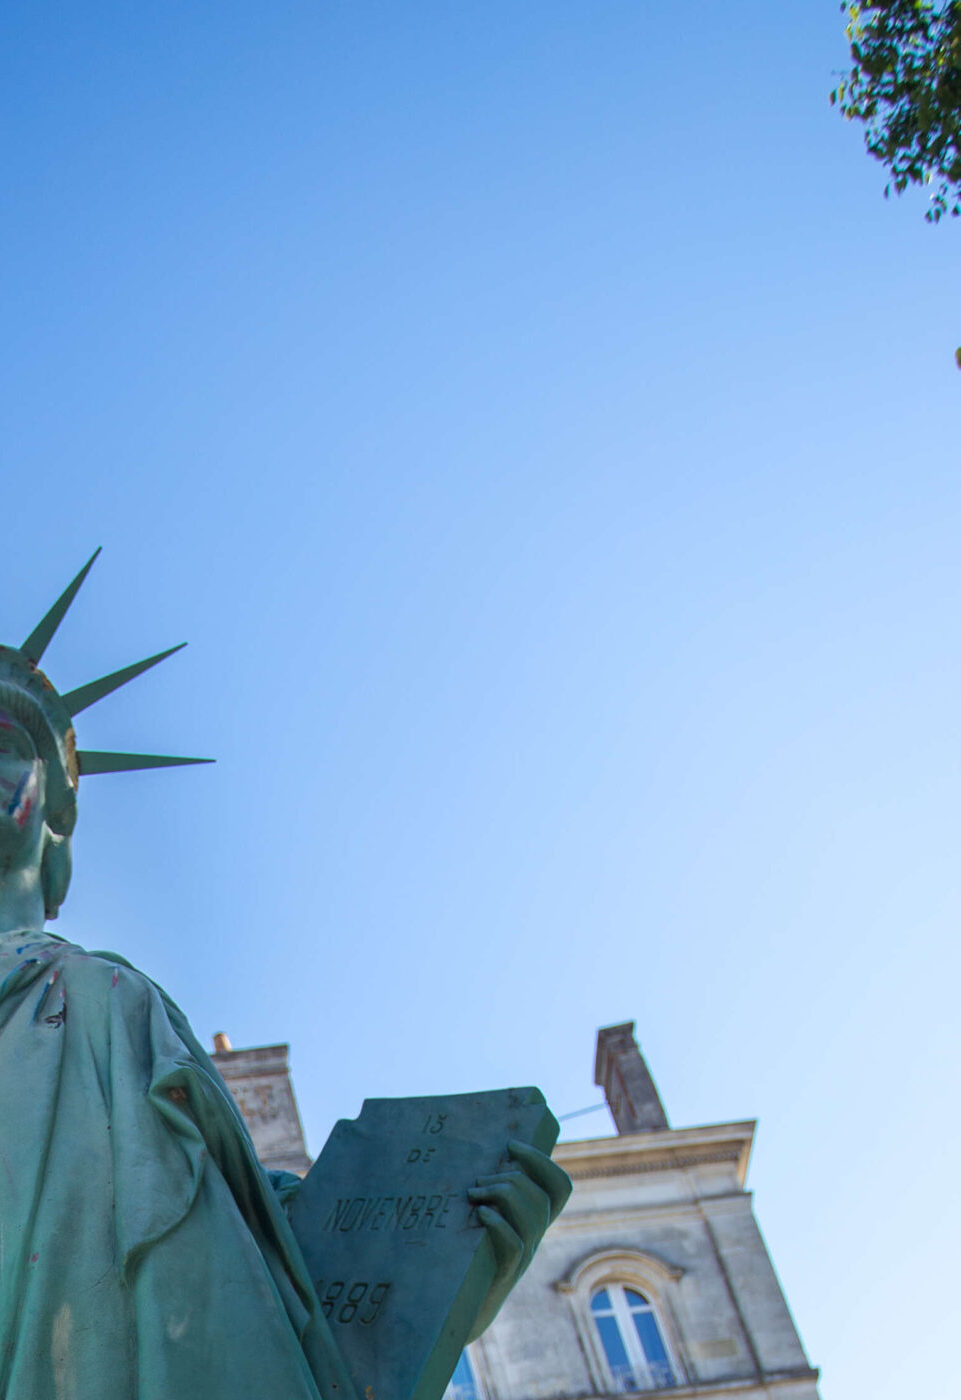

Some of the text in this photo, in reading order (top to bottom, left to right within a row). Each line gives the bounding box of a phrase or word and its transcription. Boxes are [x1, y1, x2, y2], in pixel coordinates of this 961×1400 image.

[422, 1114, 448, 1134] 15
[406, 1148, 436, 1163] DE
[322, 1193, 459, 1232] NOVEMBRE
